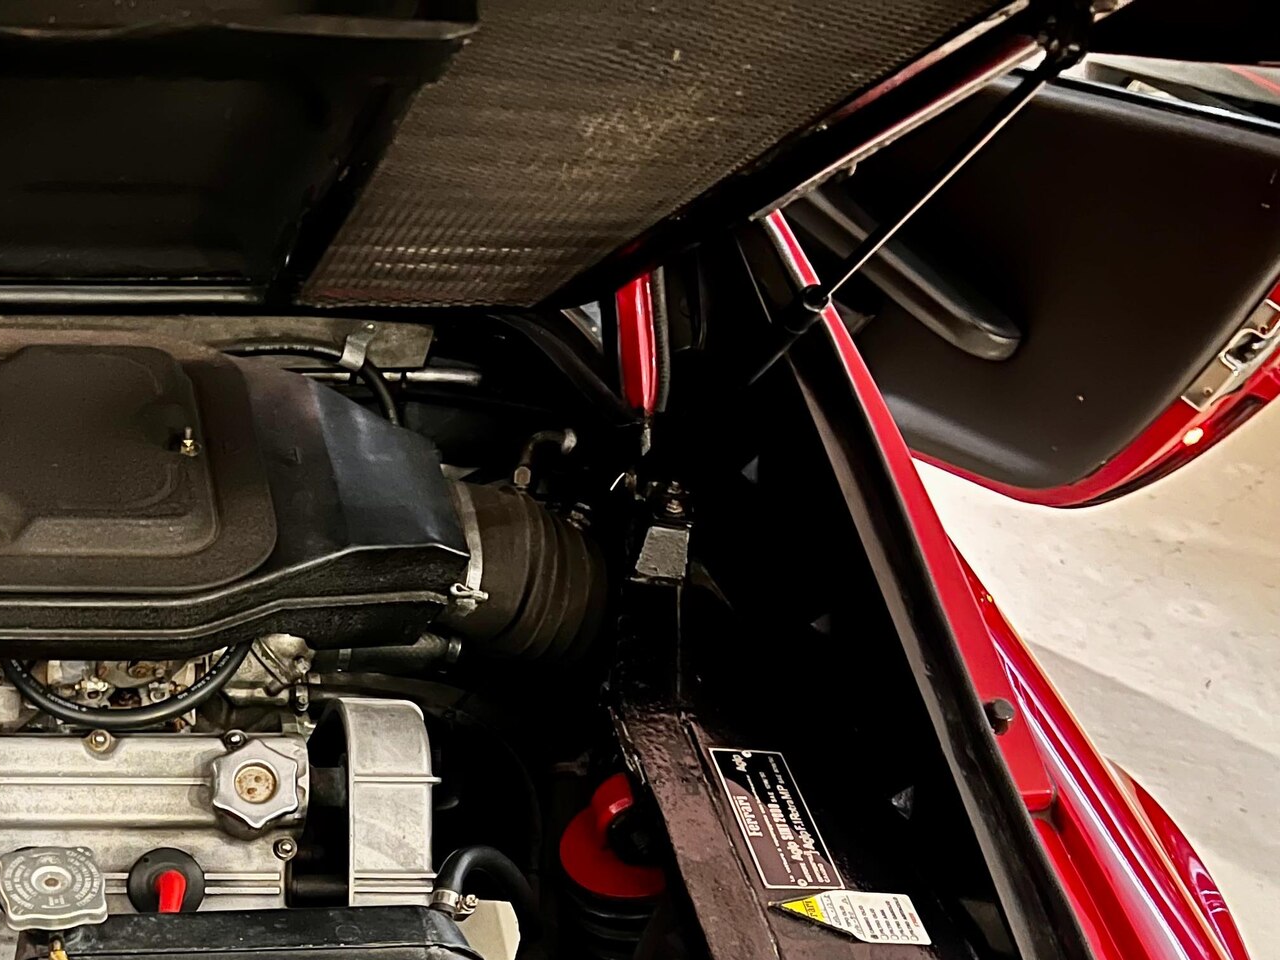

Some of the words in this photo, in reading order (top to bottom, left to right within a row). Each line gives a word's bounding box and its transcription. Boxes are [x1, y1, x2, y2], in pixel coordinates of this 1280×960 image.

[776, 785, 791, 799] MP
[734, 796, 762, 836] Ferrari
[787, 800, 801, 820] Rotra
[799, 831, 815, 850] Agip
[787, 841, 803, 861] Agip
